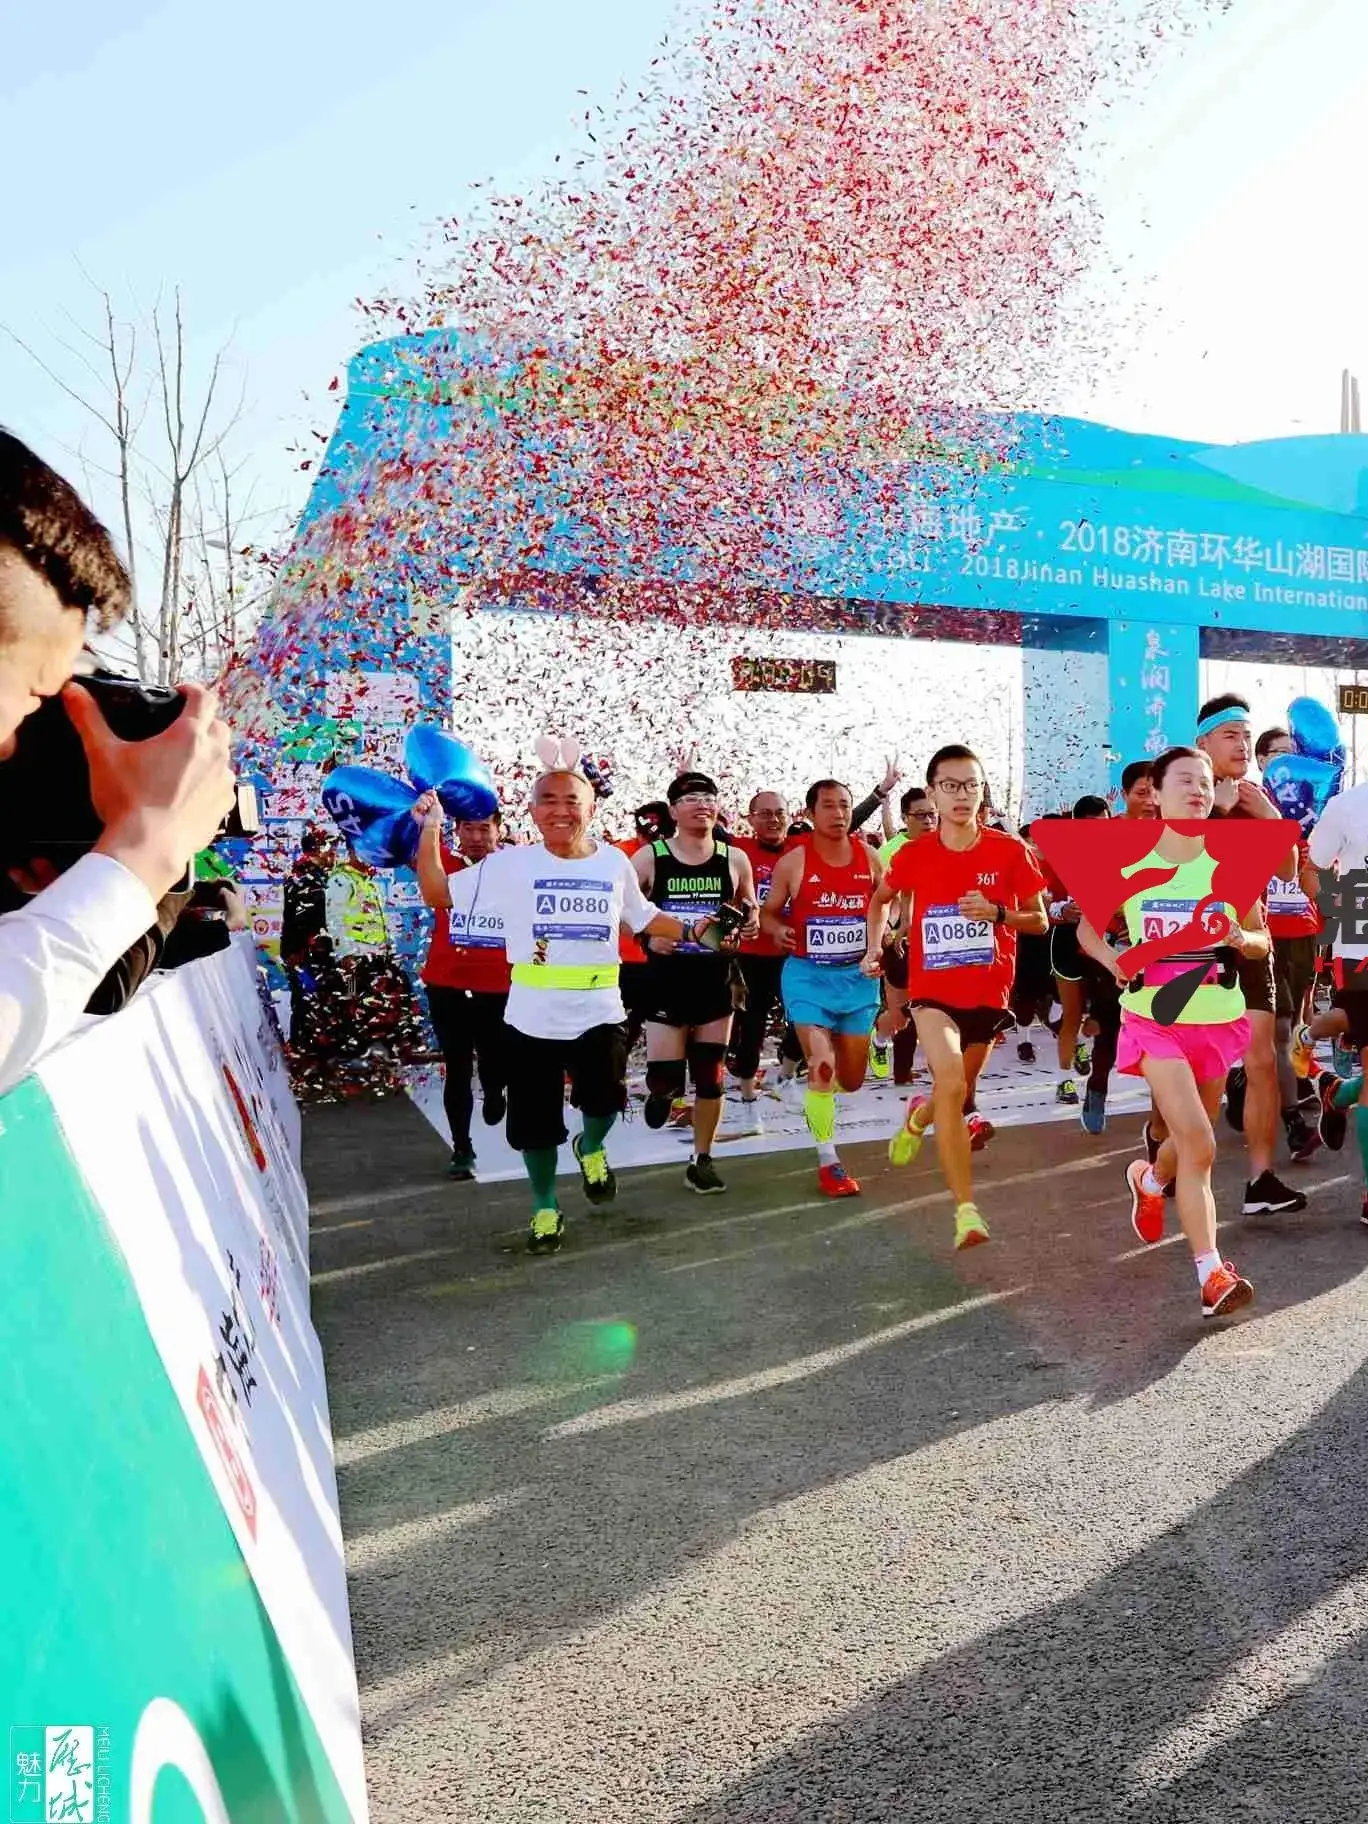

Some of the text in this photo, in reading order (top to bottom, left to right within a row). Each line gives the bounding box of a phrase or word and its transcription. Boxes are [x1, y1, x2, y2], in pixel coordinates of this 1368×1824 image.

[1093, 566, 1190, 595] Huashan
[1200, 576, 1246, 602] Lake
[667, 877, 722, 892] QIAODAN
[559, 896, 609, 915] 0880
[826, 929, 864, 945] 0602
[942, 922, 989, 940] 0862
